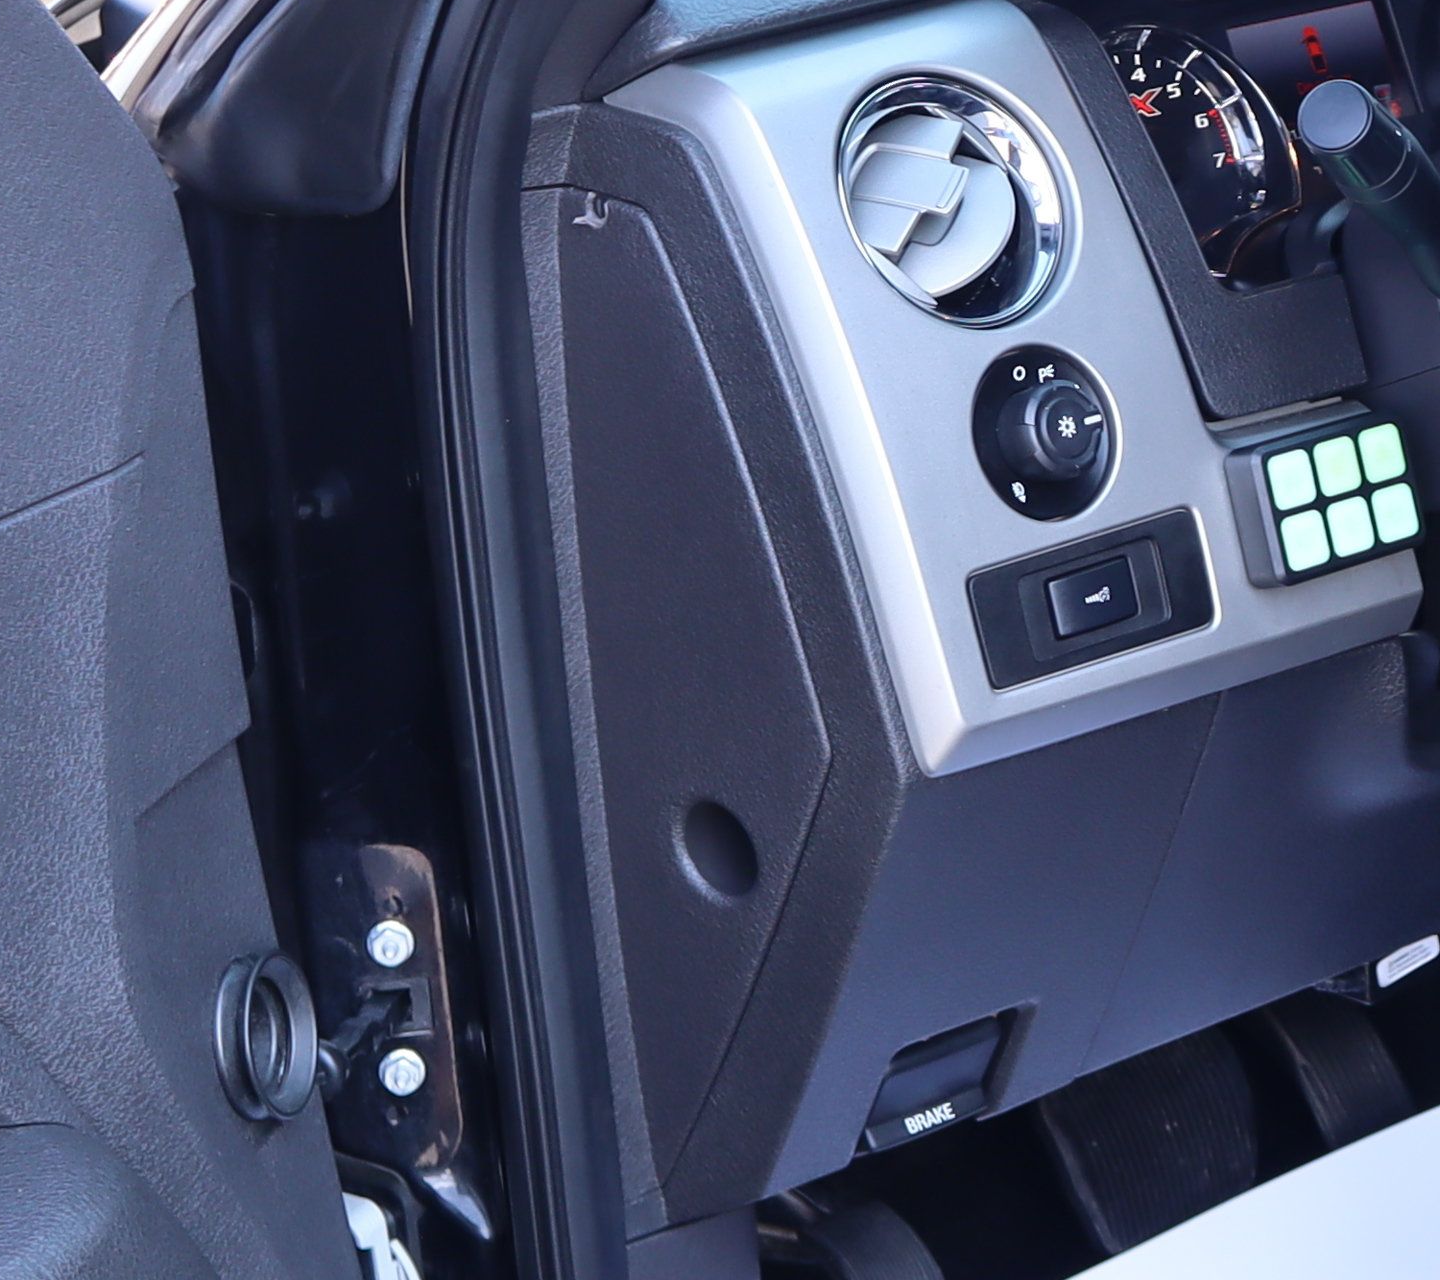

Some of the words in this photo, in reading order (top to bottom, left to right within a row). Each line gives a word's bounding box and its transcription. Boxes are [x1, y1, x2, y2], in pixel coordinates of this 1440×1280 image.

[1130, 67, 1147, 82] 4
[1166, 82, 1182, 99] 5
[1194, 112, 1210, 128] 6
[1213, 151, 1226, 168] 7
[904, 1102, 956, 1135] BRAKE
